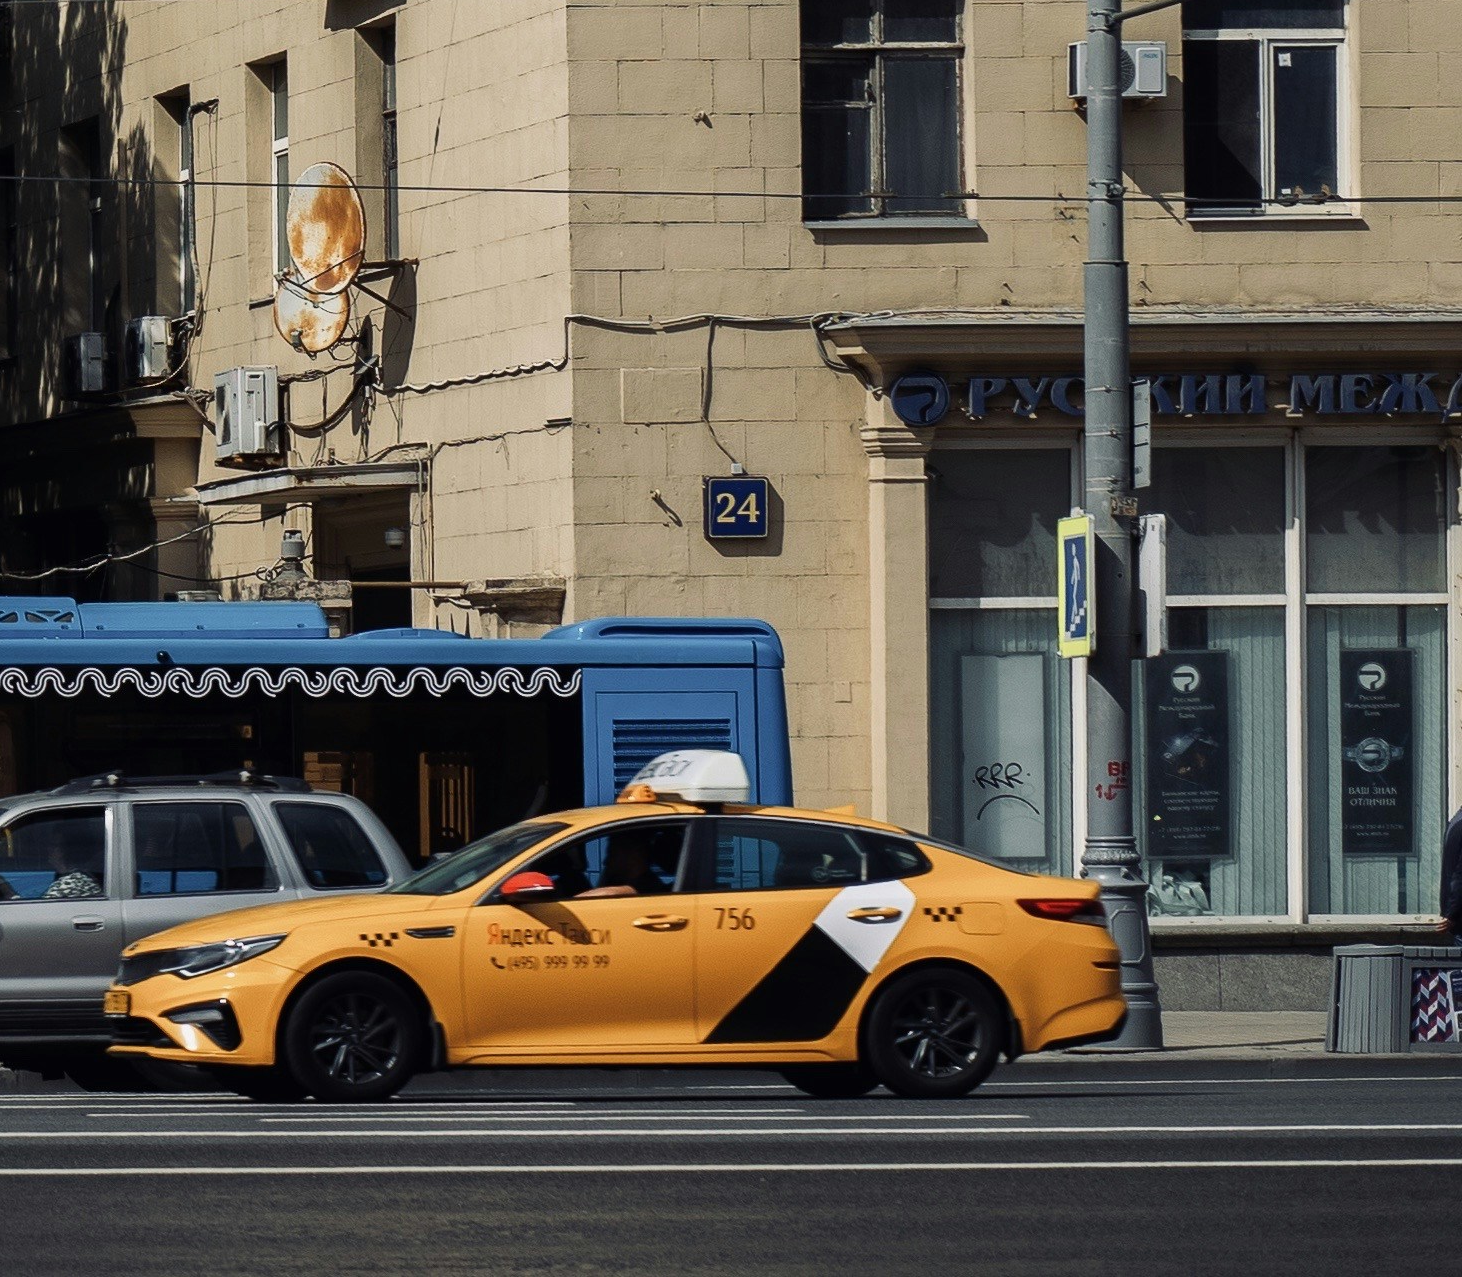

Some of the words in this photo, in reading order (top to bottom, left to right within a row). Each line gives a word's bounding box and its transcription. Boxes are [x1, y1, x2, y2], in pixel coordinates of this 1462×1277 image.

[968, 371, 1267, 417] РУСКИЙ
[716, 492, 760, 523] 24
[715, 907, 756, 931] 756
[487, 922, 553, 948] Яндекс
[559, 921, 612, 946] Такси
[543, 954, 568, 970] 999
[571, 954, 590, 970] 99
[593, 954, 611, 969] 99
